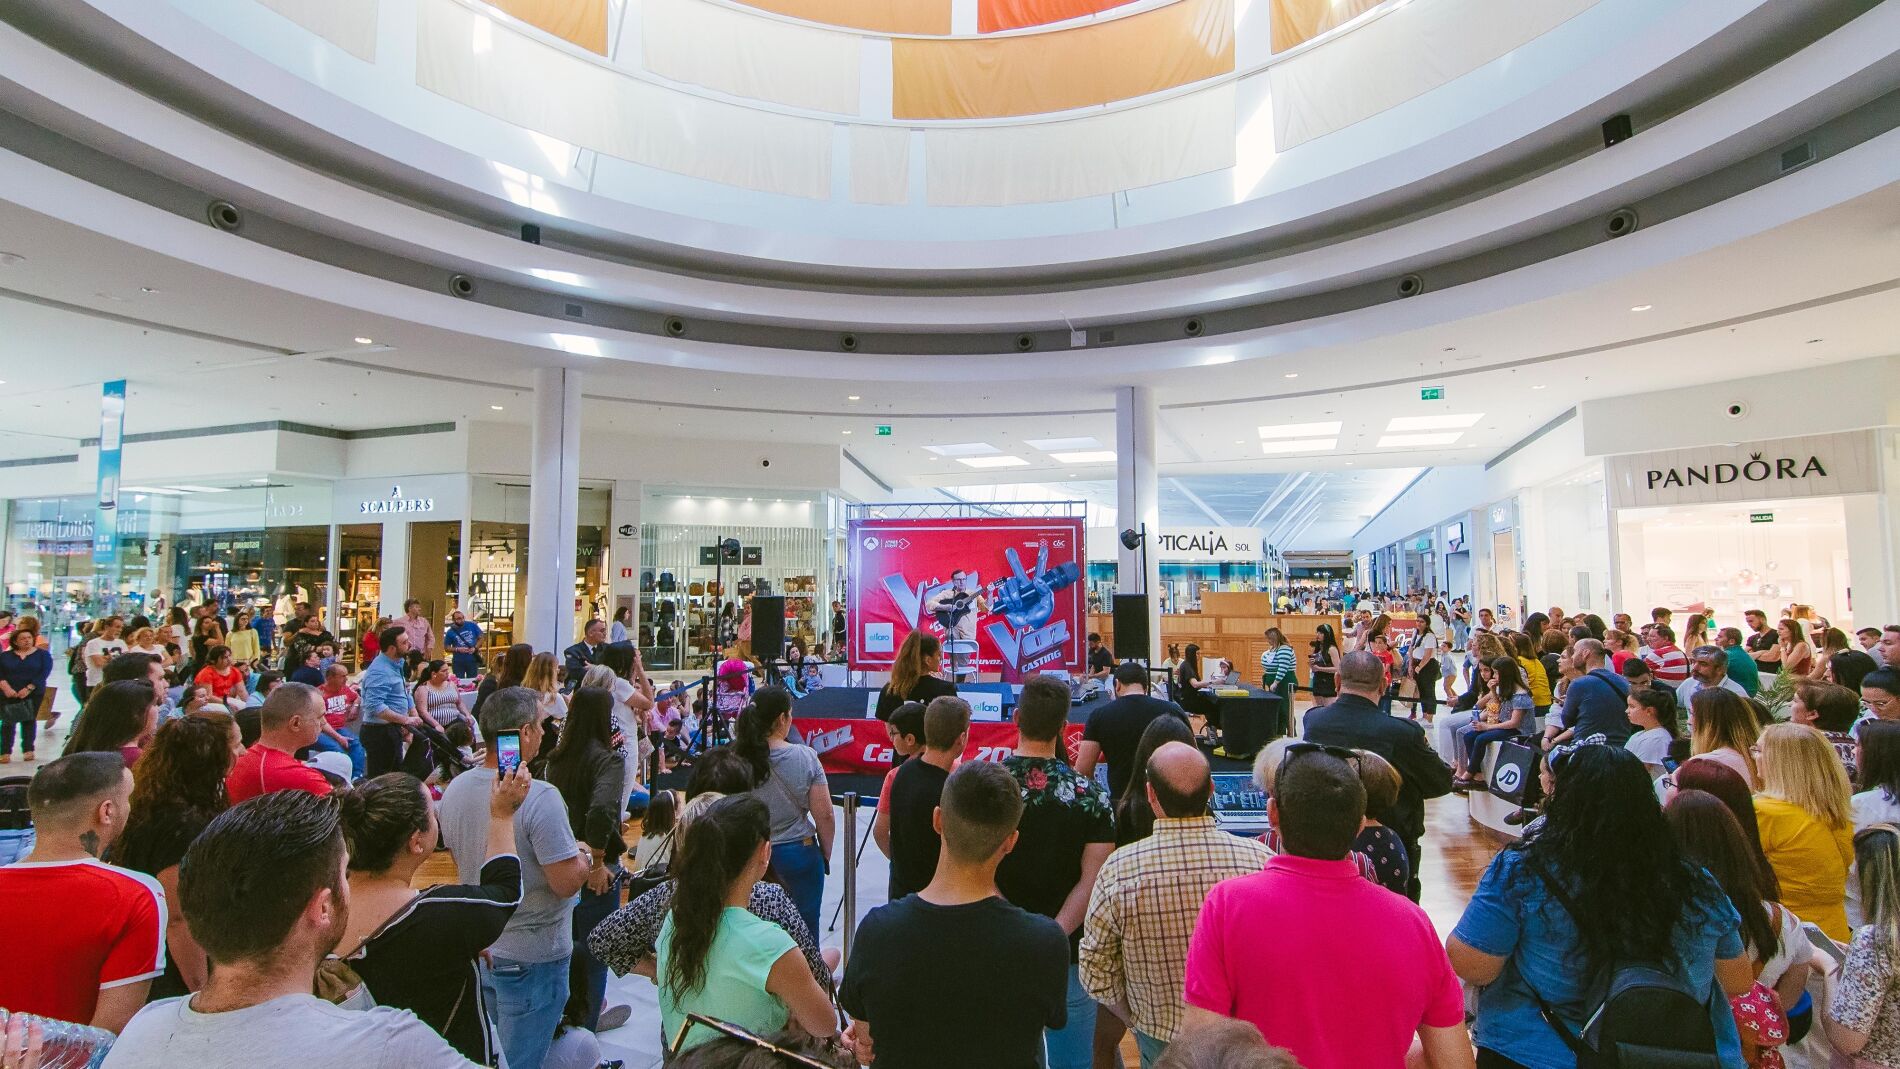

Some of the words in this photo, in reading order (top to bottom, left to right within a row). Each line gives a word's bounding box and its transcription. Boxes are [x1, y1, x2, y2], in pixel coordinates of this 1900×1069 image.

[1647, 452, 1827, 490] PANDORA
[361, 498, 433, 514] SCALPERS
[57, 514, 94, 538] Louis
[1235, 543, 1251, 551] SOL
[925, 577, 940, 589] LA
[1022, 625, 1035, 635] LA
[984, 619, 1071, 670] VOZ
[1022, 650, 1062, 673] CASTING
[812, 727, 824, 736] LA
[1499, 770, 1518, 785] JD
